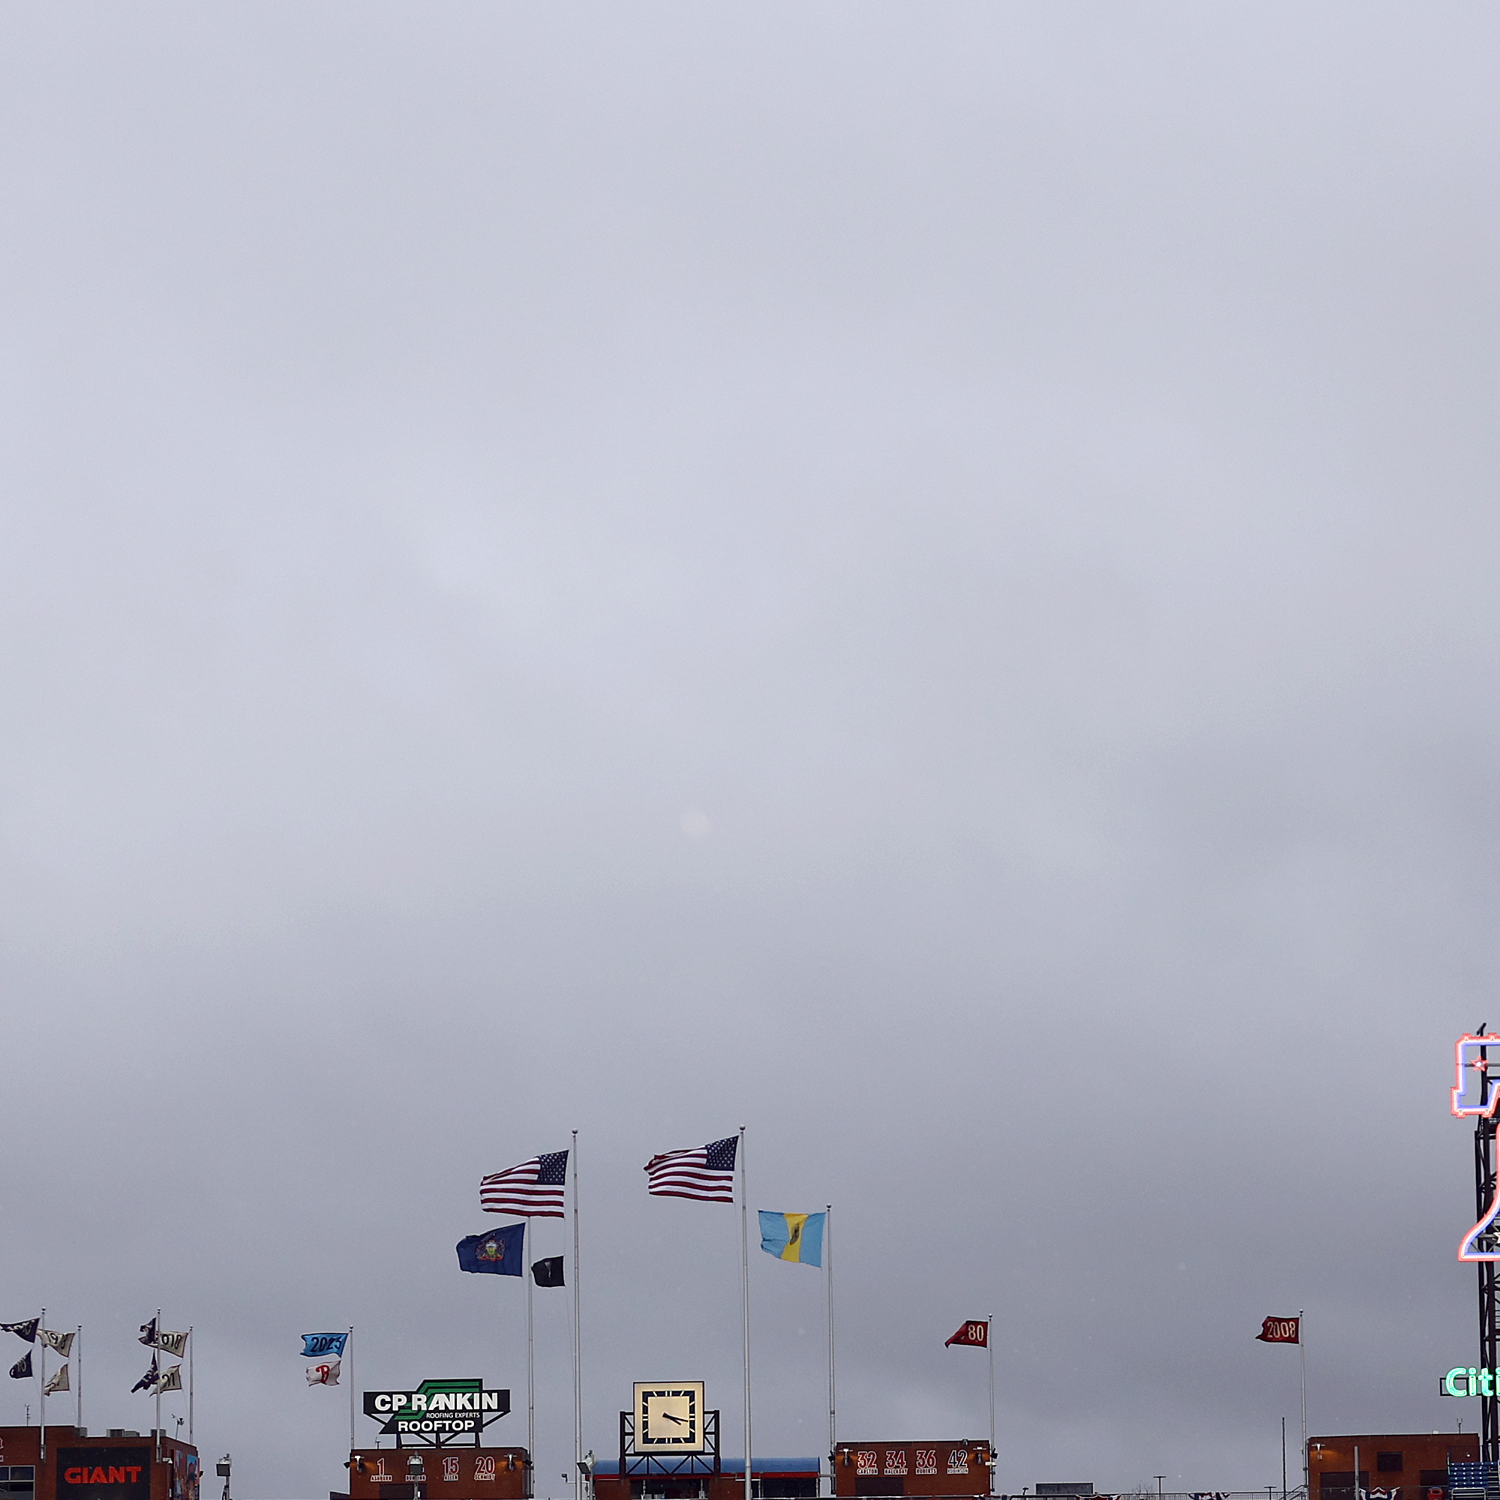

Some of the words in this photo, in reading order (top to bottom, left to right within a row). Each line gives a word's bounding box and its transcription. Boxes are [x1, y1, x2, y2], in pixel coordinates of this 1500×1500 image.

[1266, 1320, 1297, 1339] 2008
[375, 1394, 407, 1412] CP
[411, 1392, 498, 1411] RANKIN
[398, 1420, 475, 1432] ROOFTOP
[377, 1457, 385, 1476] 1
[442, 1457, 460, 1474] 15
[475, 1456, 496, 1475] 20
[857, 1451, 877, 1468] 32
[885, 1450, 906, 1468] 34
[915, 1450, 936, 1468] 36
[947, 1450, 968, 1468] 42
[63, 1466, 142, 1484] GIANT
